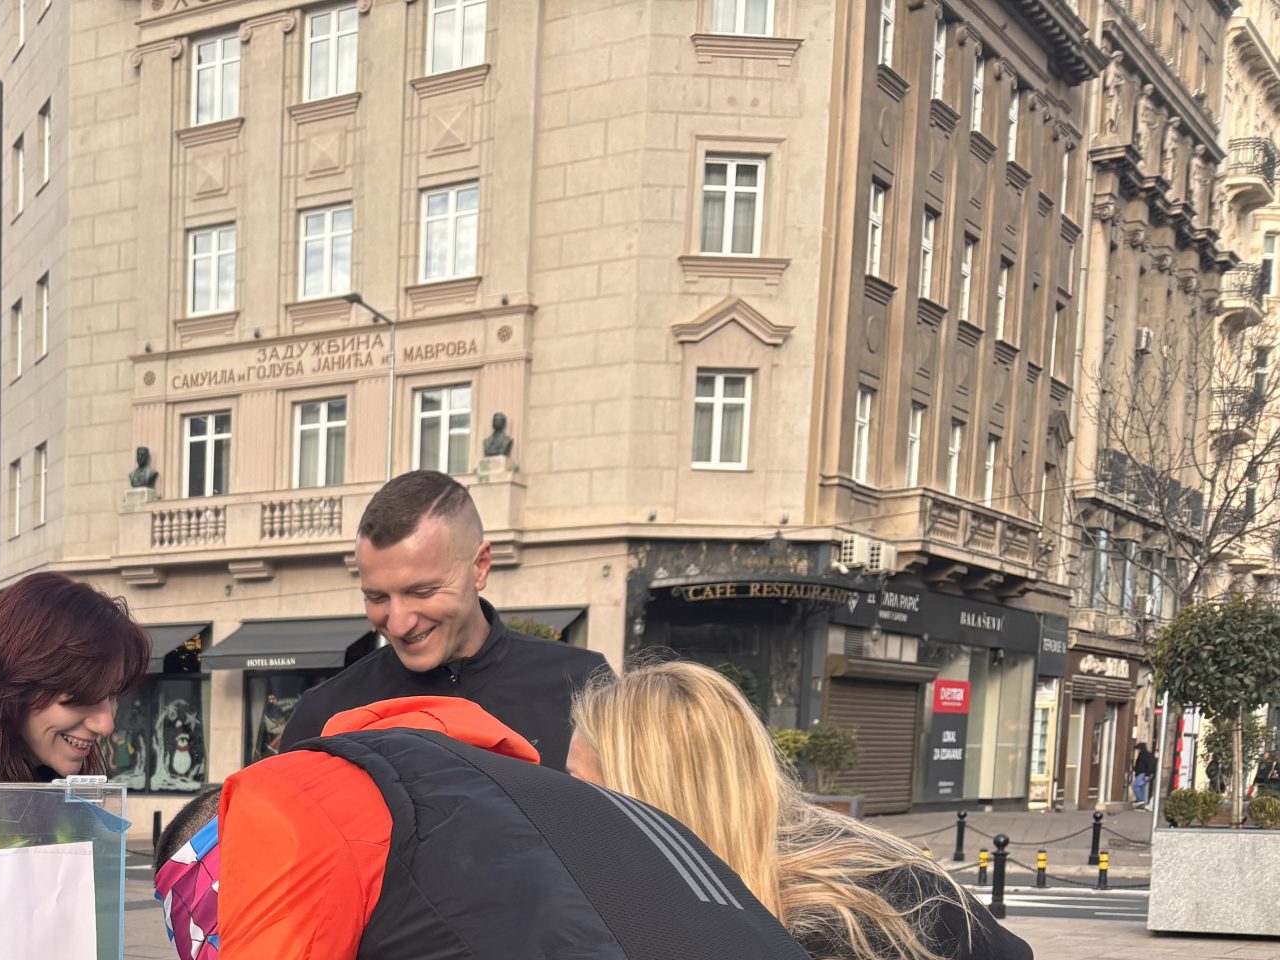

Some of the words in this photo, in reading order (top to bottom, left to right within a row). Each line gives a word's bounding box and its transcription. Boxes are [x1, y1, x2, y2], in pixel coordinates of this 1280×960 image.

[256, 333, 385, 363] ЗАДУЖБИНА
[172, 368, 236, 390] САМУИЛА
[247, 361, 304, 382] ГОЛУБА
[404, 338, 478, 363] МАВРОВА
[687, 583, 736, 601] CAFE
[749, 582, 850, 603] RESTAURANT
[246, 658, 268, 667] HOTEL
[269, 657, 296, 667] BALKAN
